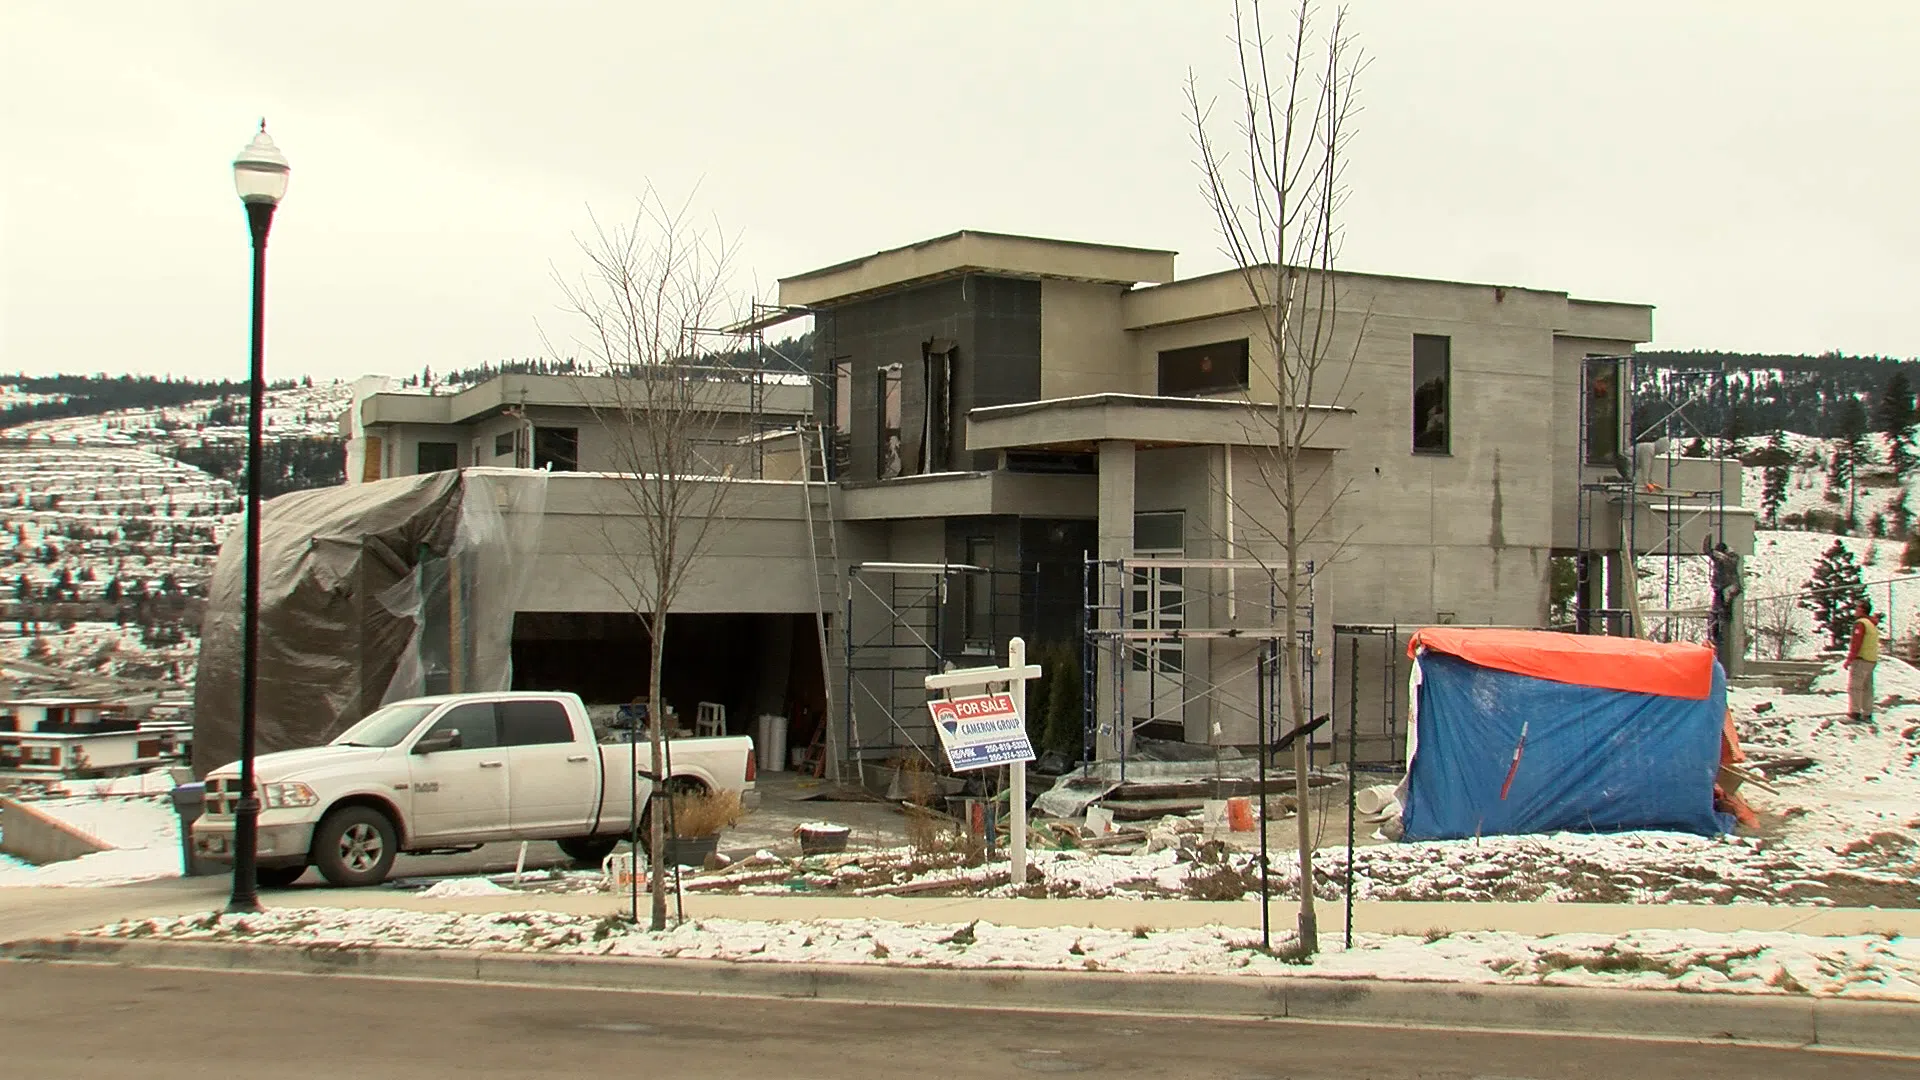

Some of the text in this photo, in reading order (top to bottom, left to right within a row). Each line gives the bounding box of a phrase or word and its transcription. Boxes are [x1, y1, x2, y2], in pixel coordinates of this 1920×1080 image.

[955, 699, 1008, 715] FOR SALE
[961, 718, 1020, 735] CAMERON GROUP
